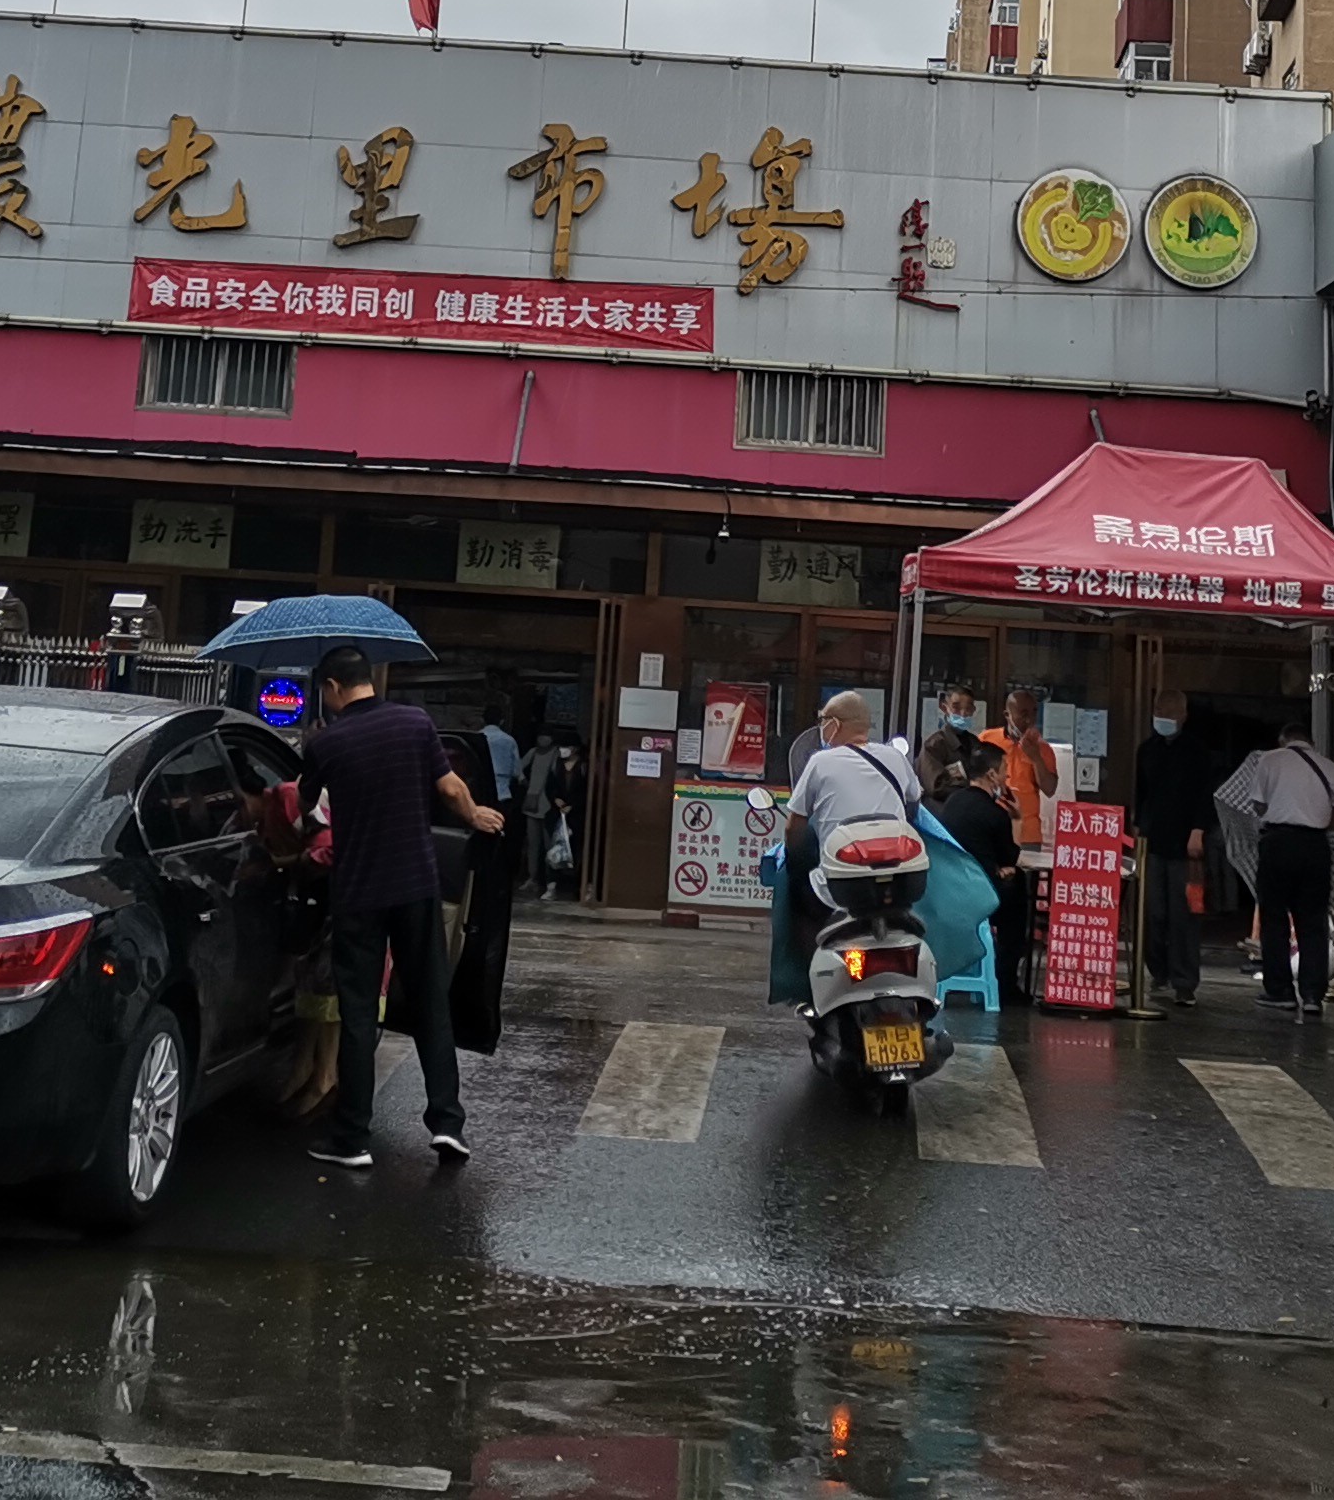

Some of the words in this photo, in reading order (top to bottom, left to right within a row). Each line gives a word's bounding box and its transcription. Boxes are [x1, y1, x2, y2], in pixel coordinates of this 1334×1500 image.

[147, 275, 415, 321] 食品安全你我同创
[434, 289, 702, 336] 健康生活大家共享
[1092, 514, 1276, 556] 圣劳伦斯
[464, 537, 554, 573] 勤消毒
[1014, 565, 1226, 605] 圣劳伦斯散热器
[1243, 579, 1303, 609] 地暖
[1058, 809, 1119, 838] 进入市场
[1056, 844, 1117, 873] 戴好口罩
[1055, 880, 1115, 909] 自觉排队
